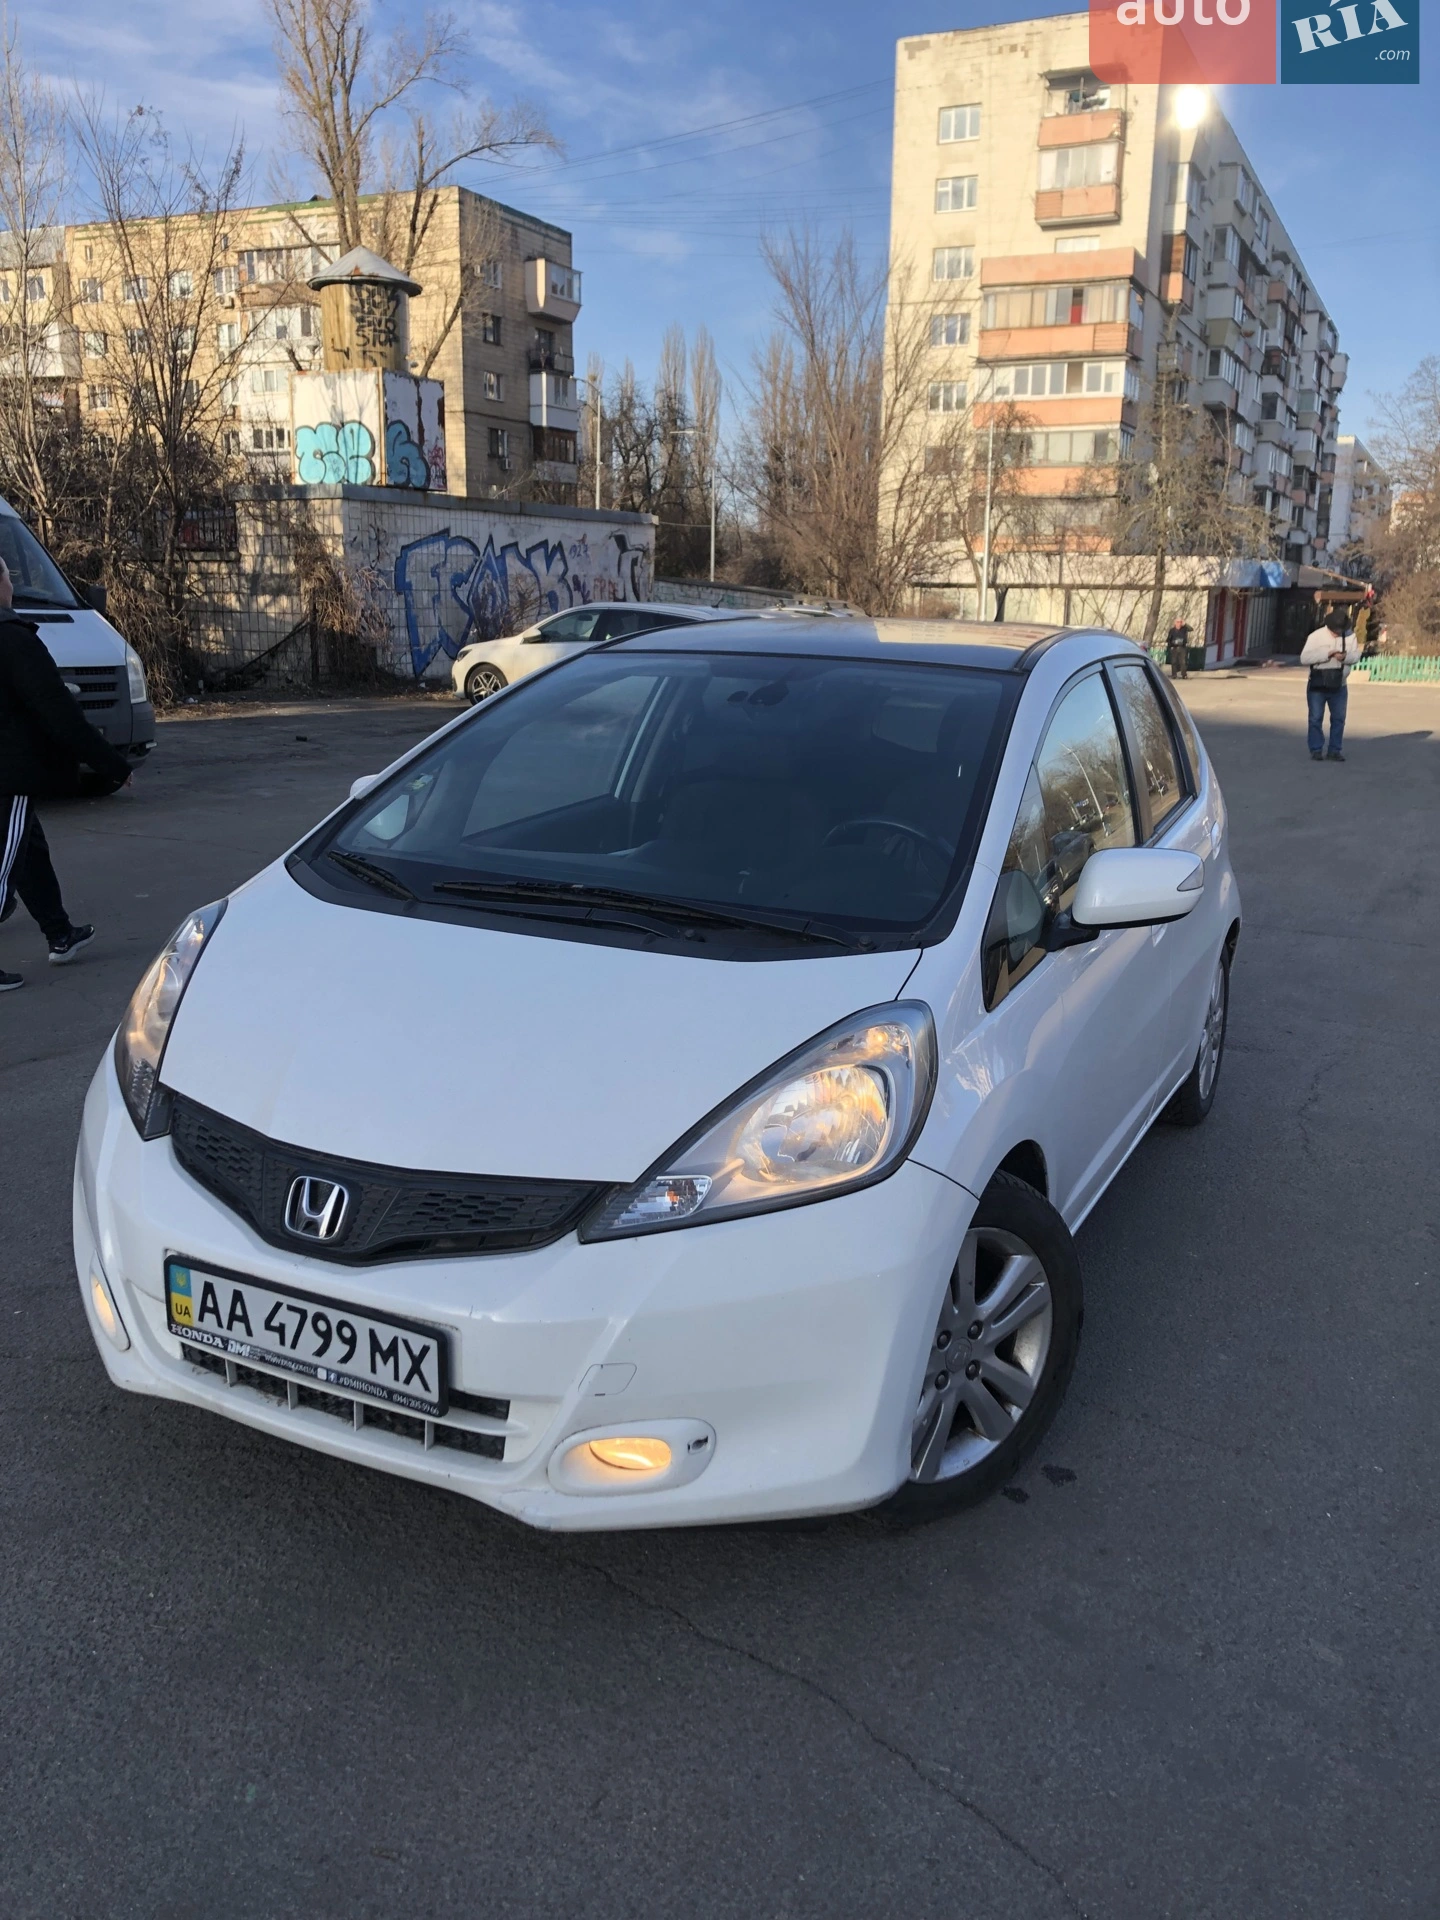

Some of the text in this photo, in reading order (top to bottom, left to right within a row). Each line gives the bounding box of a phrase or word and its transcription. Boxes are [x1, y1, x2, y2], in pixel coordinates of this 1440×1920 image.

[175, 1303, 192, 1318] UA
[170, 1323, 225, 1349] HONDA
[198, 1280, 432, 1393] AA 4799 MX
